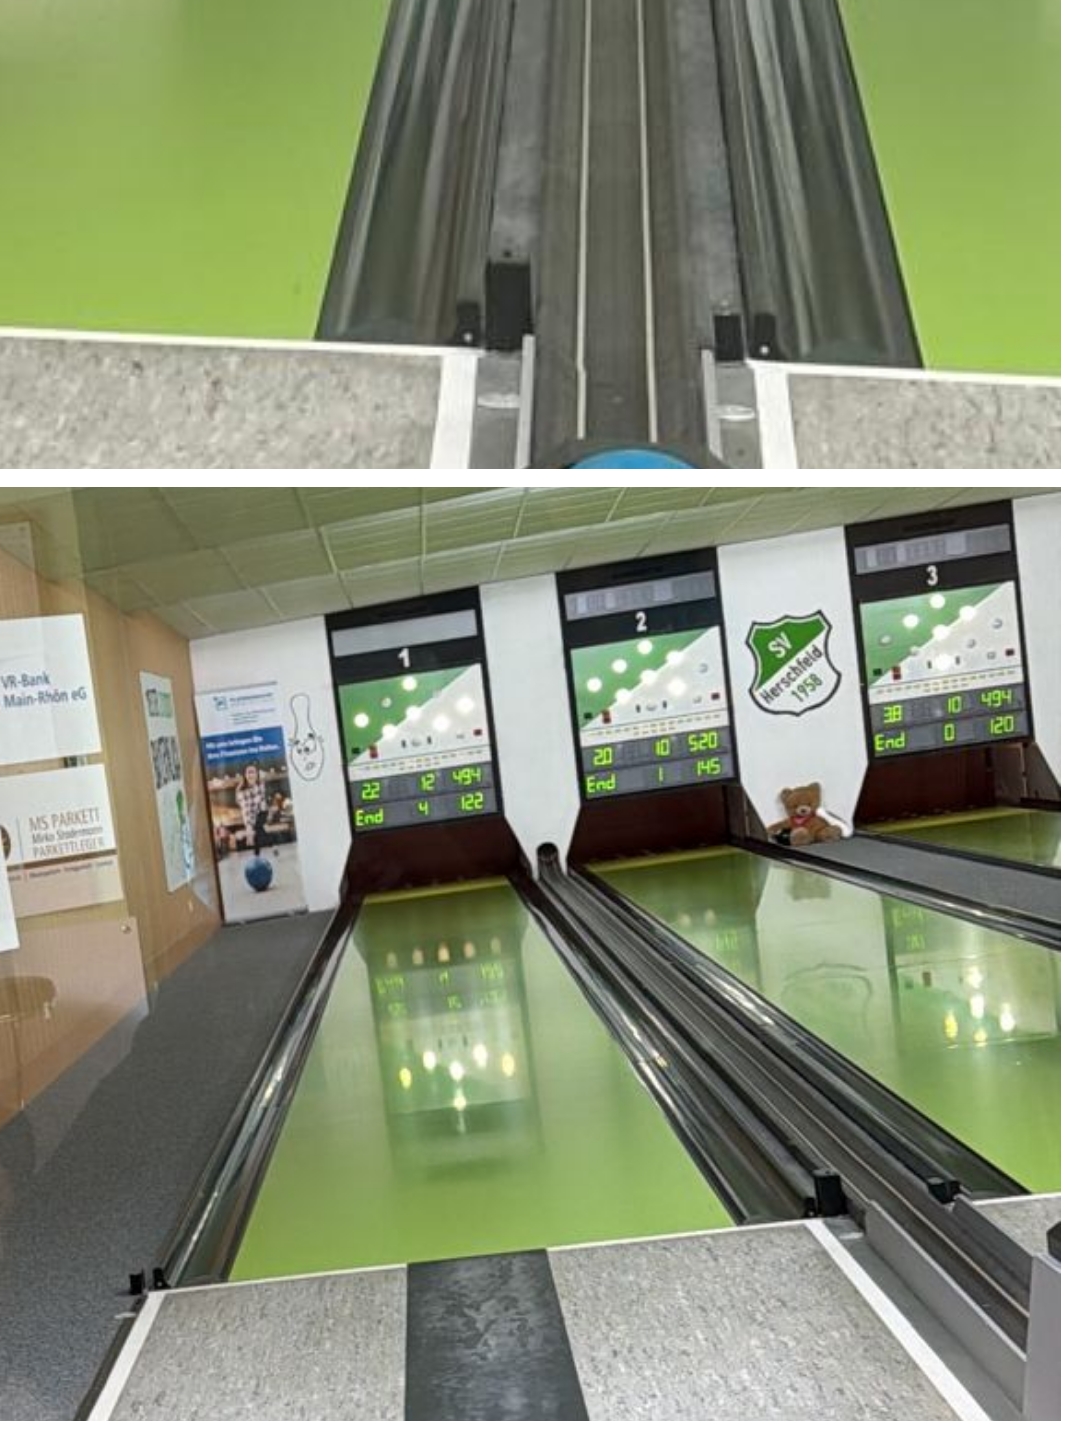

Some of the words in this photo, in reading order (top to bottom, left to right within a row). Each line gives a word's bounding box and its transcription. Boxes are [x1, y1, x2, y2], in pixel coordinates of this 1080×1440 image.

[926, 564, 939, 586] 3
[634, 610, 648, 632] 2
[397, 647, 411, 668] 1
[767, 631, 793, 659] SV
[0, 672, 51, 690] VR-Bank
[760, 644, 824, 704] Herschfeld
[3, 689, 69, 709] Main-Rhön
[71, 686, 88, 702] eG
[790, 673, 824, 702] 1958
[947, 695, 962, 714] 10
[980, 689, 1013, 708] 494
[655, 738, 670, 757] 10
[688, 731, 718, 752] 520
[874, 730, 906, 752] End
[944, 723, 955, 742] 0
[990, 715, 1015, 734] 120
[420, 773, 435, 791] 12
[452, 767, 482, 785] 494
[585, 773, 616, 793] End
[696, 757, 721, 776] 145
[29, 813, 49, 832] MS
[51, 806, 100, 829] PARKETT
[355, 808, 384, 827] End
[418, 801, 429, 816] 4
[460, 791, 484, 811] 122
[33, 836, 105, 858] PARKETTLEGER
